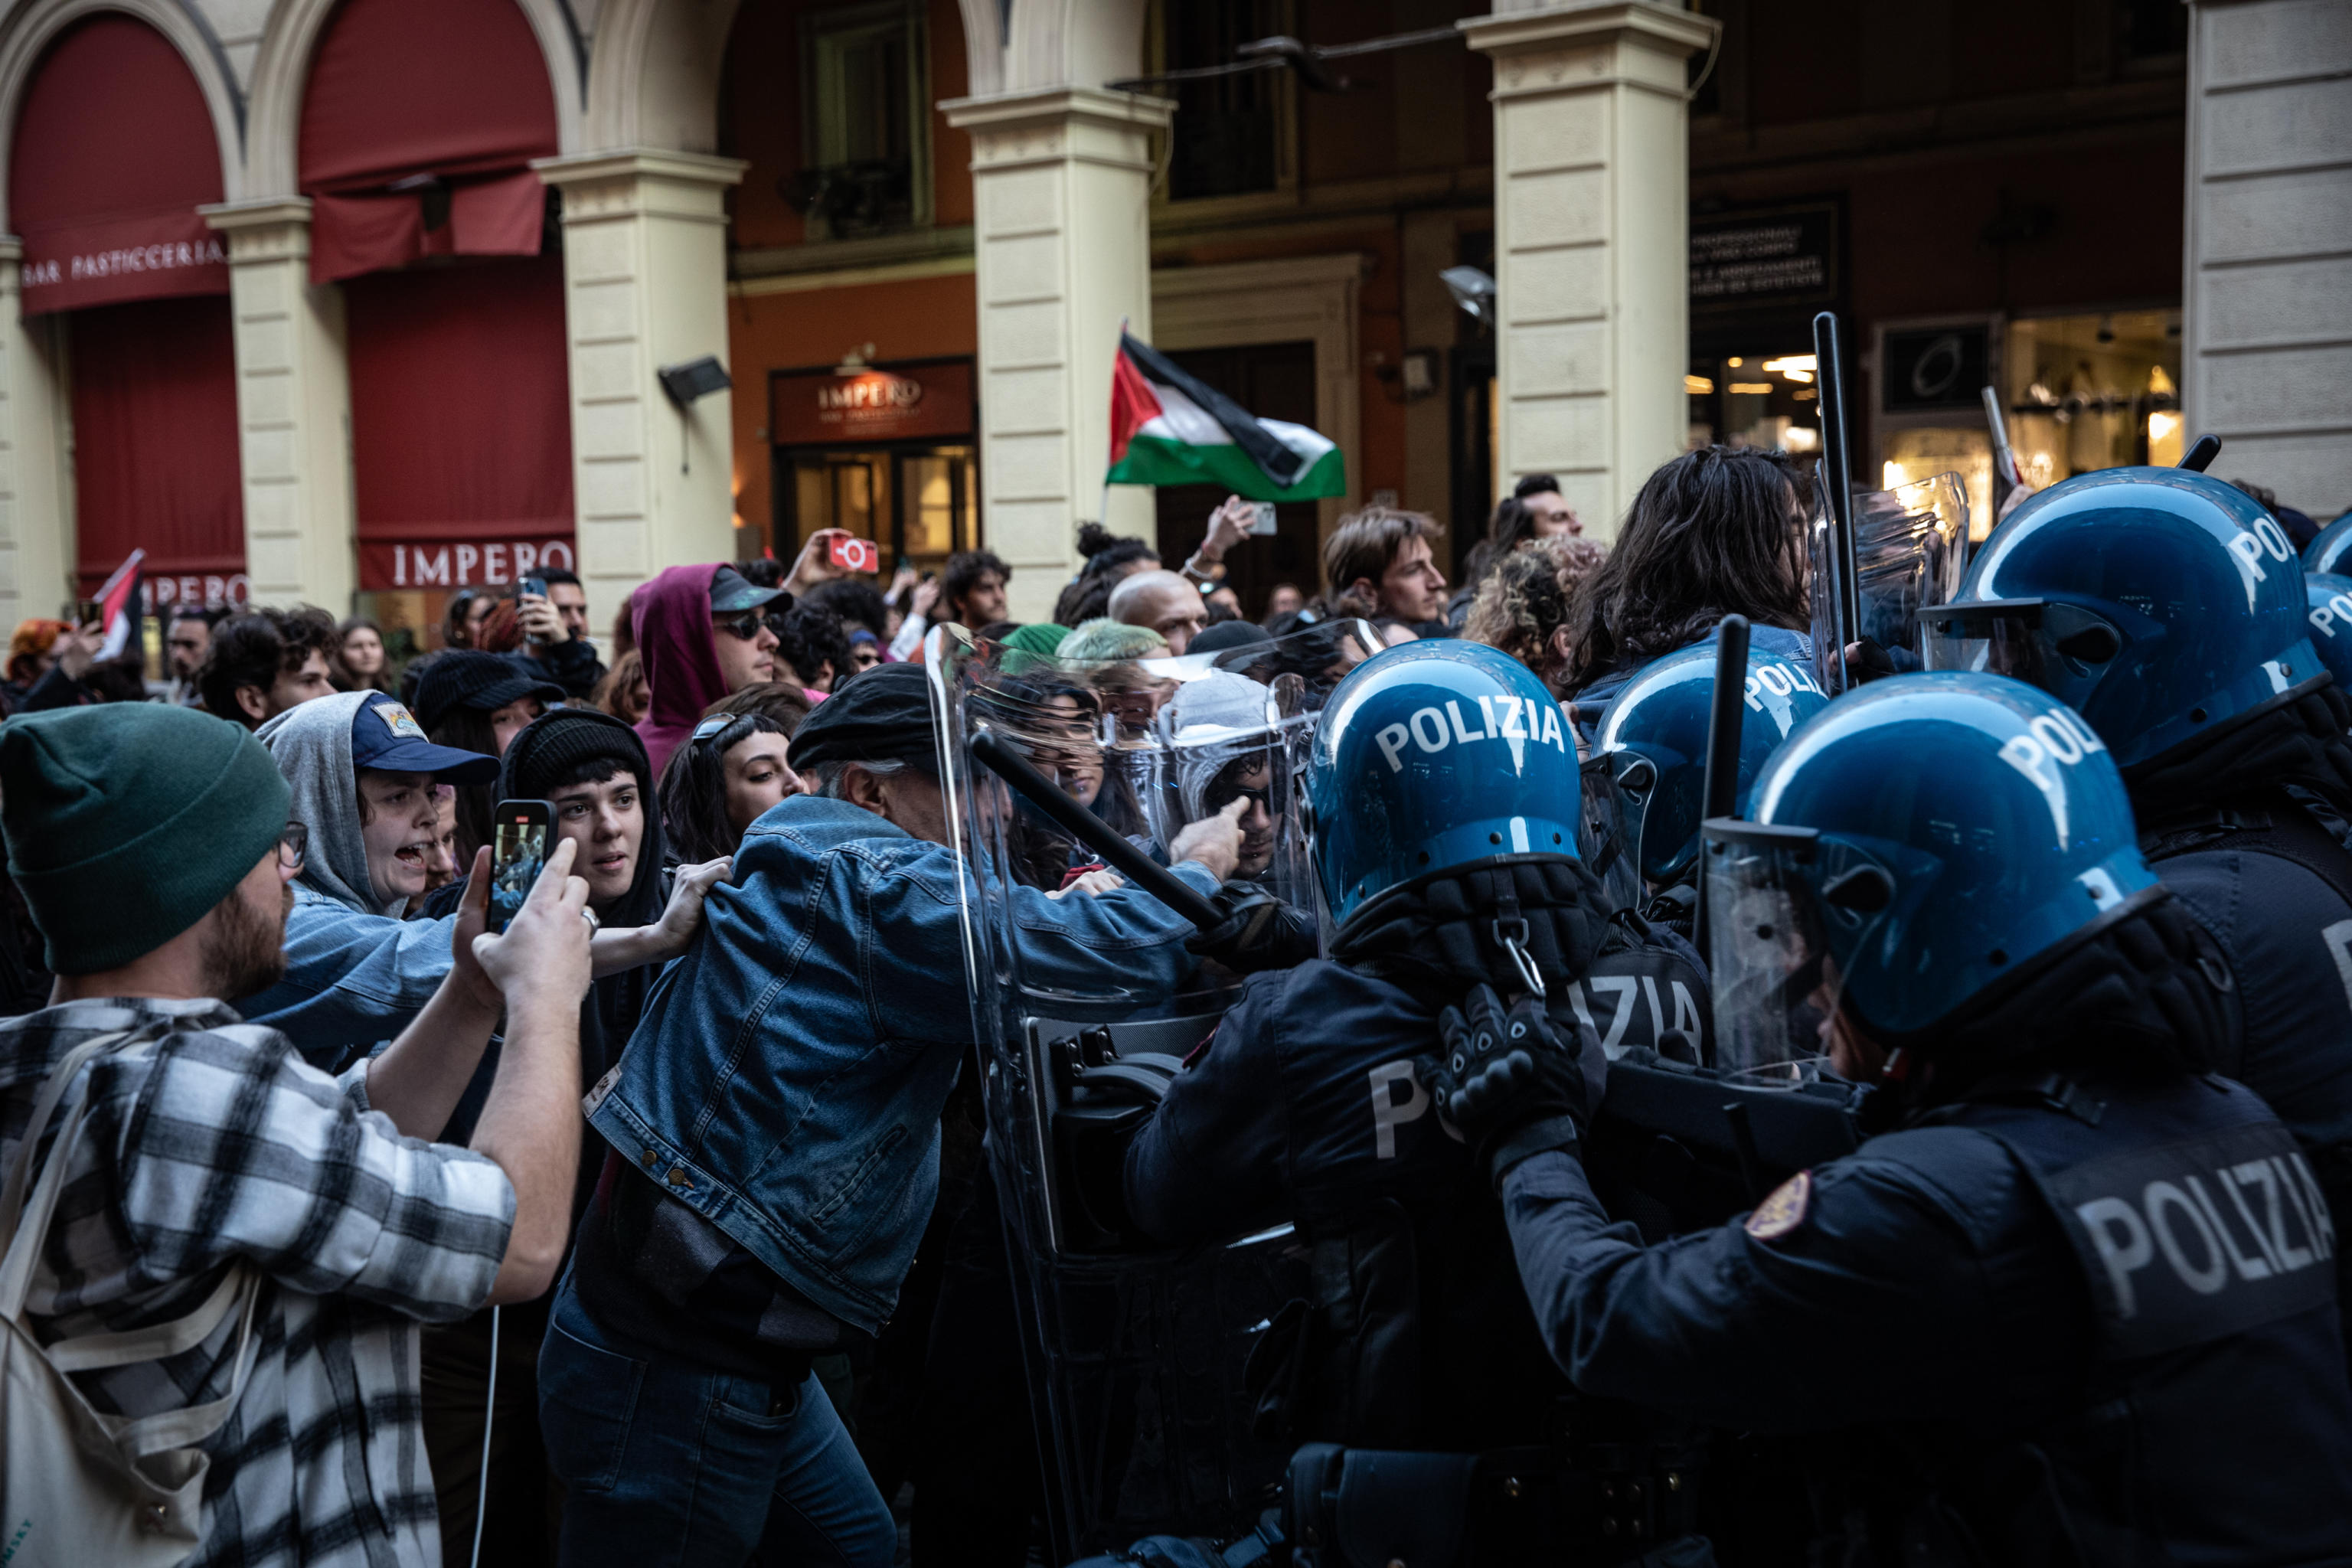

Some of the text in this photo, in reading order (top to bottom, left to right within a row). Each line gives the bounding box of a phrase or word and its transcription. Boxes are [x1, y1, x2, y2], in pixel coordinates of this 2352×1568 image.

[70, 238, 227, 280] PASTICCERIA
[818, 379, 921, 410] IMPERO
[393, 540, 573, 586] IMPERO
[1375, 695, 1565, 773] POLIZIA
[2075, 1152, 2336, 1320] POLIZIA
